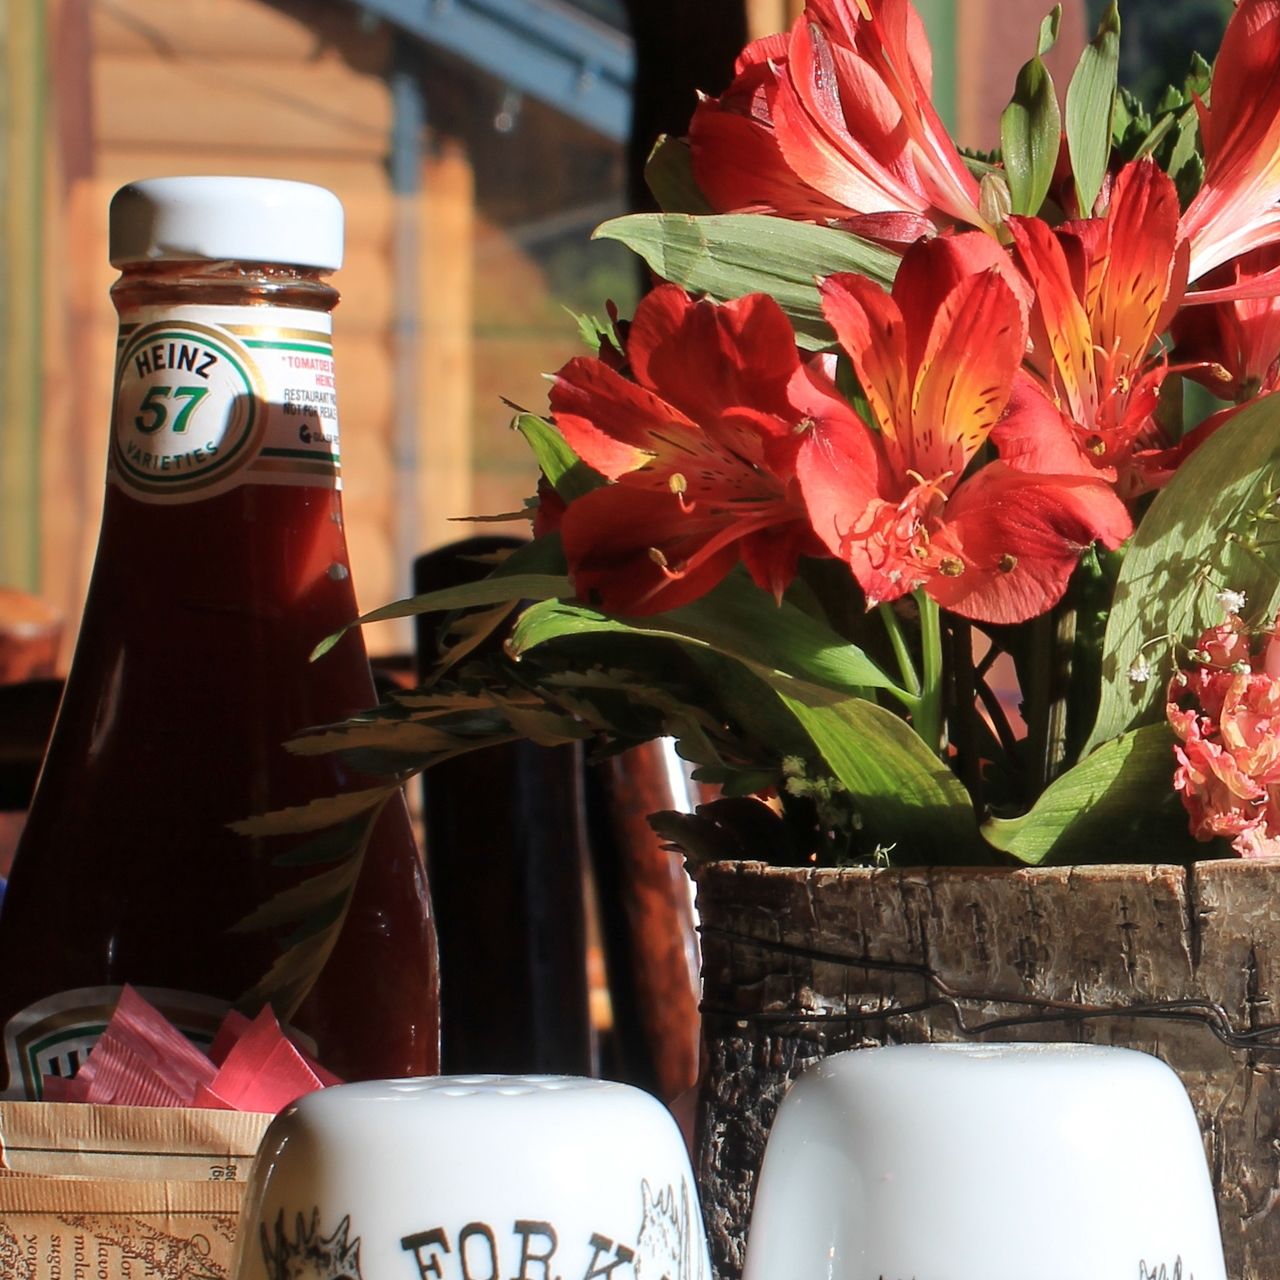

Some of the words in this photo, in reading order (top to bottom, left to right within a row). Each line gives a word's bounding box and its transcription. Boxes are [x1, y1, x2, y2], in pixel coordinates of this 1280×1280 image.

[135, 343, 218, 379] HEINZ
[135, 386, 212, 434] 57
[127, 440, 218, 470] VARIETIES
